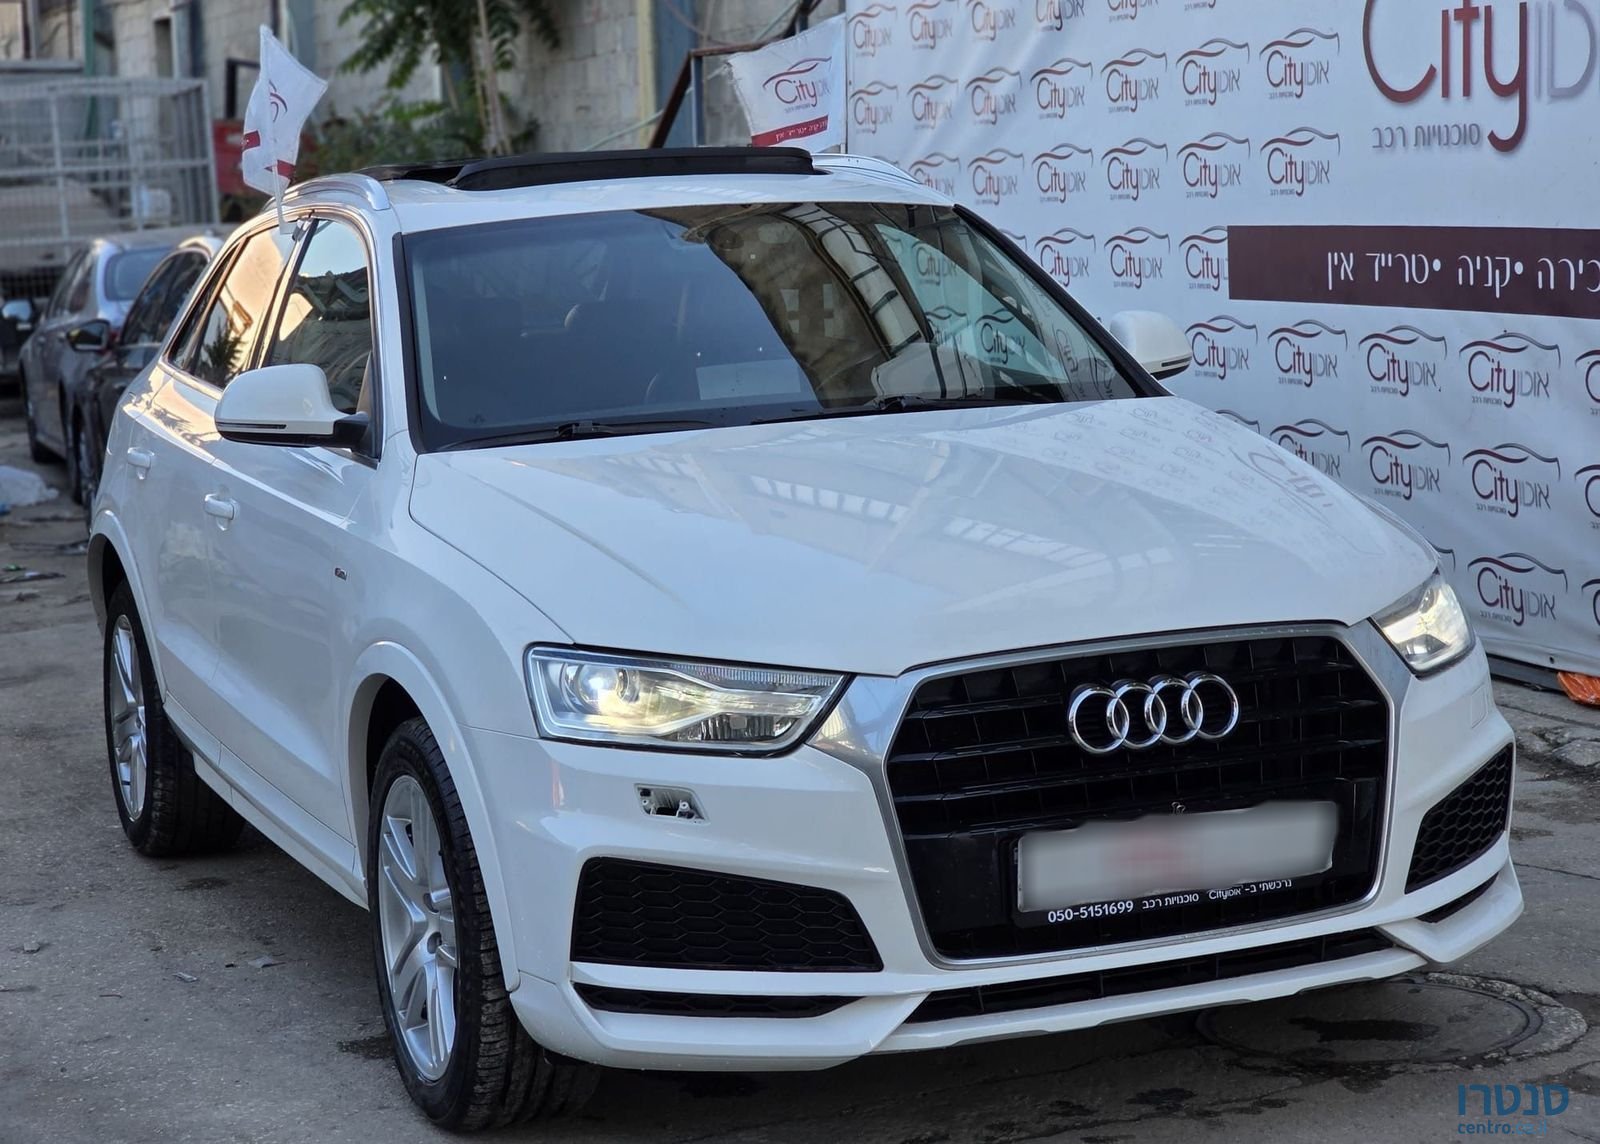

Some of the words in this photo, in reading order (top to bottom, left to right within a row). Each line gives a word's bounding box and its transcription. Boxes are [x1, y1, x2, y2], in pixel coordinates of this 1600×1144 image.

[1362, 0, 1528, 153] City
[775, 79, 818, 107] City
[1372, 126, 1407, 149] רכב
[1414, 123, 1481, 148] סוכנויות
[1327, 251, 1354, 290] אין
[1365, 253, 1430, 284] טרייד
[1457, 254, 1511, 298] קניה
[1537, 257, 1600, 292] כירה
[1259, 879, 1292, 892] נרכשתי
[1048, 900, 1134, 923] 050-5151699
[1142, 898, 1162, 910] רכב
[1164, 893, 1199, 906] סוכנויות
